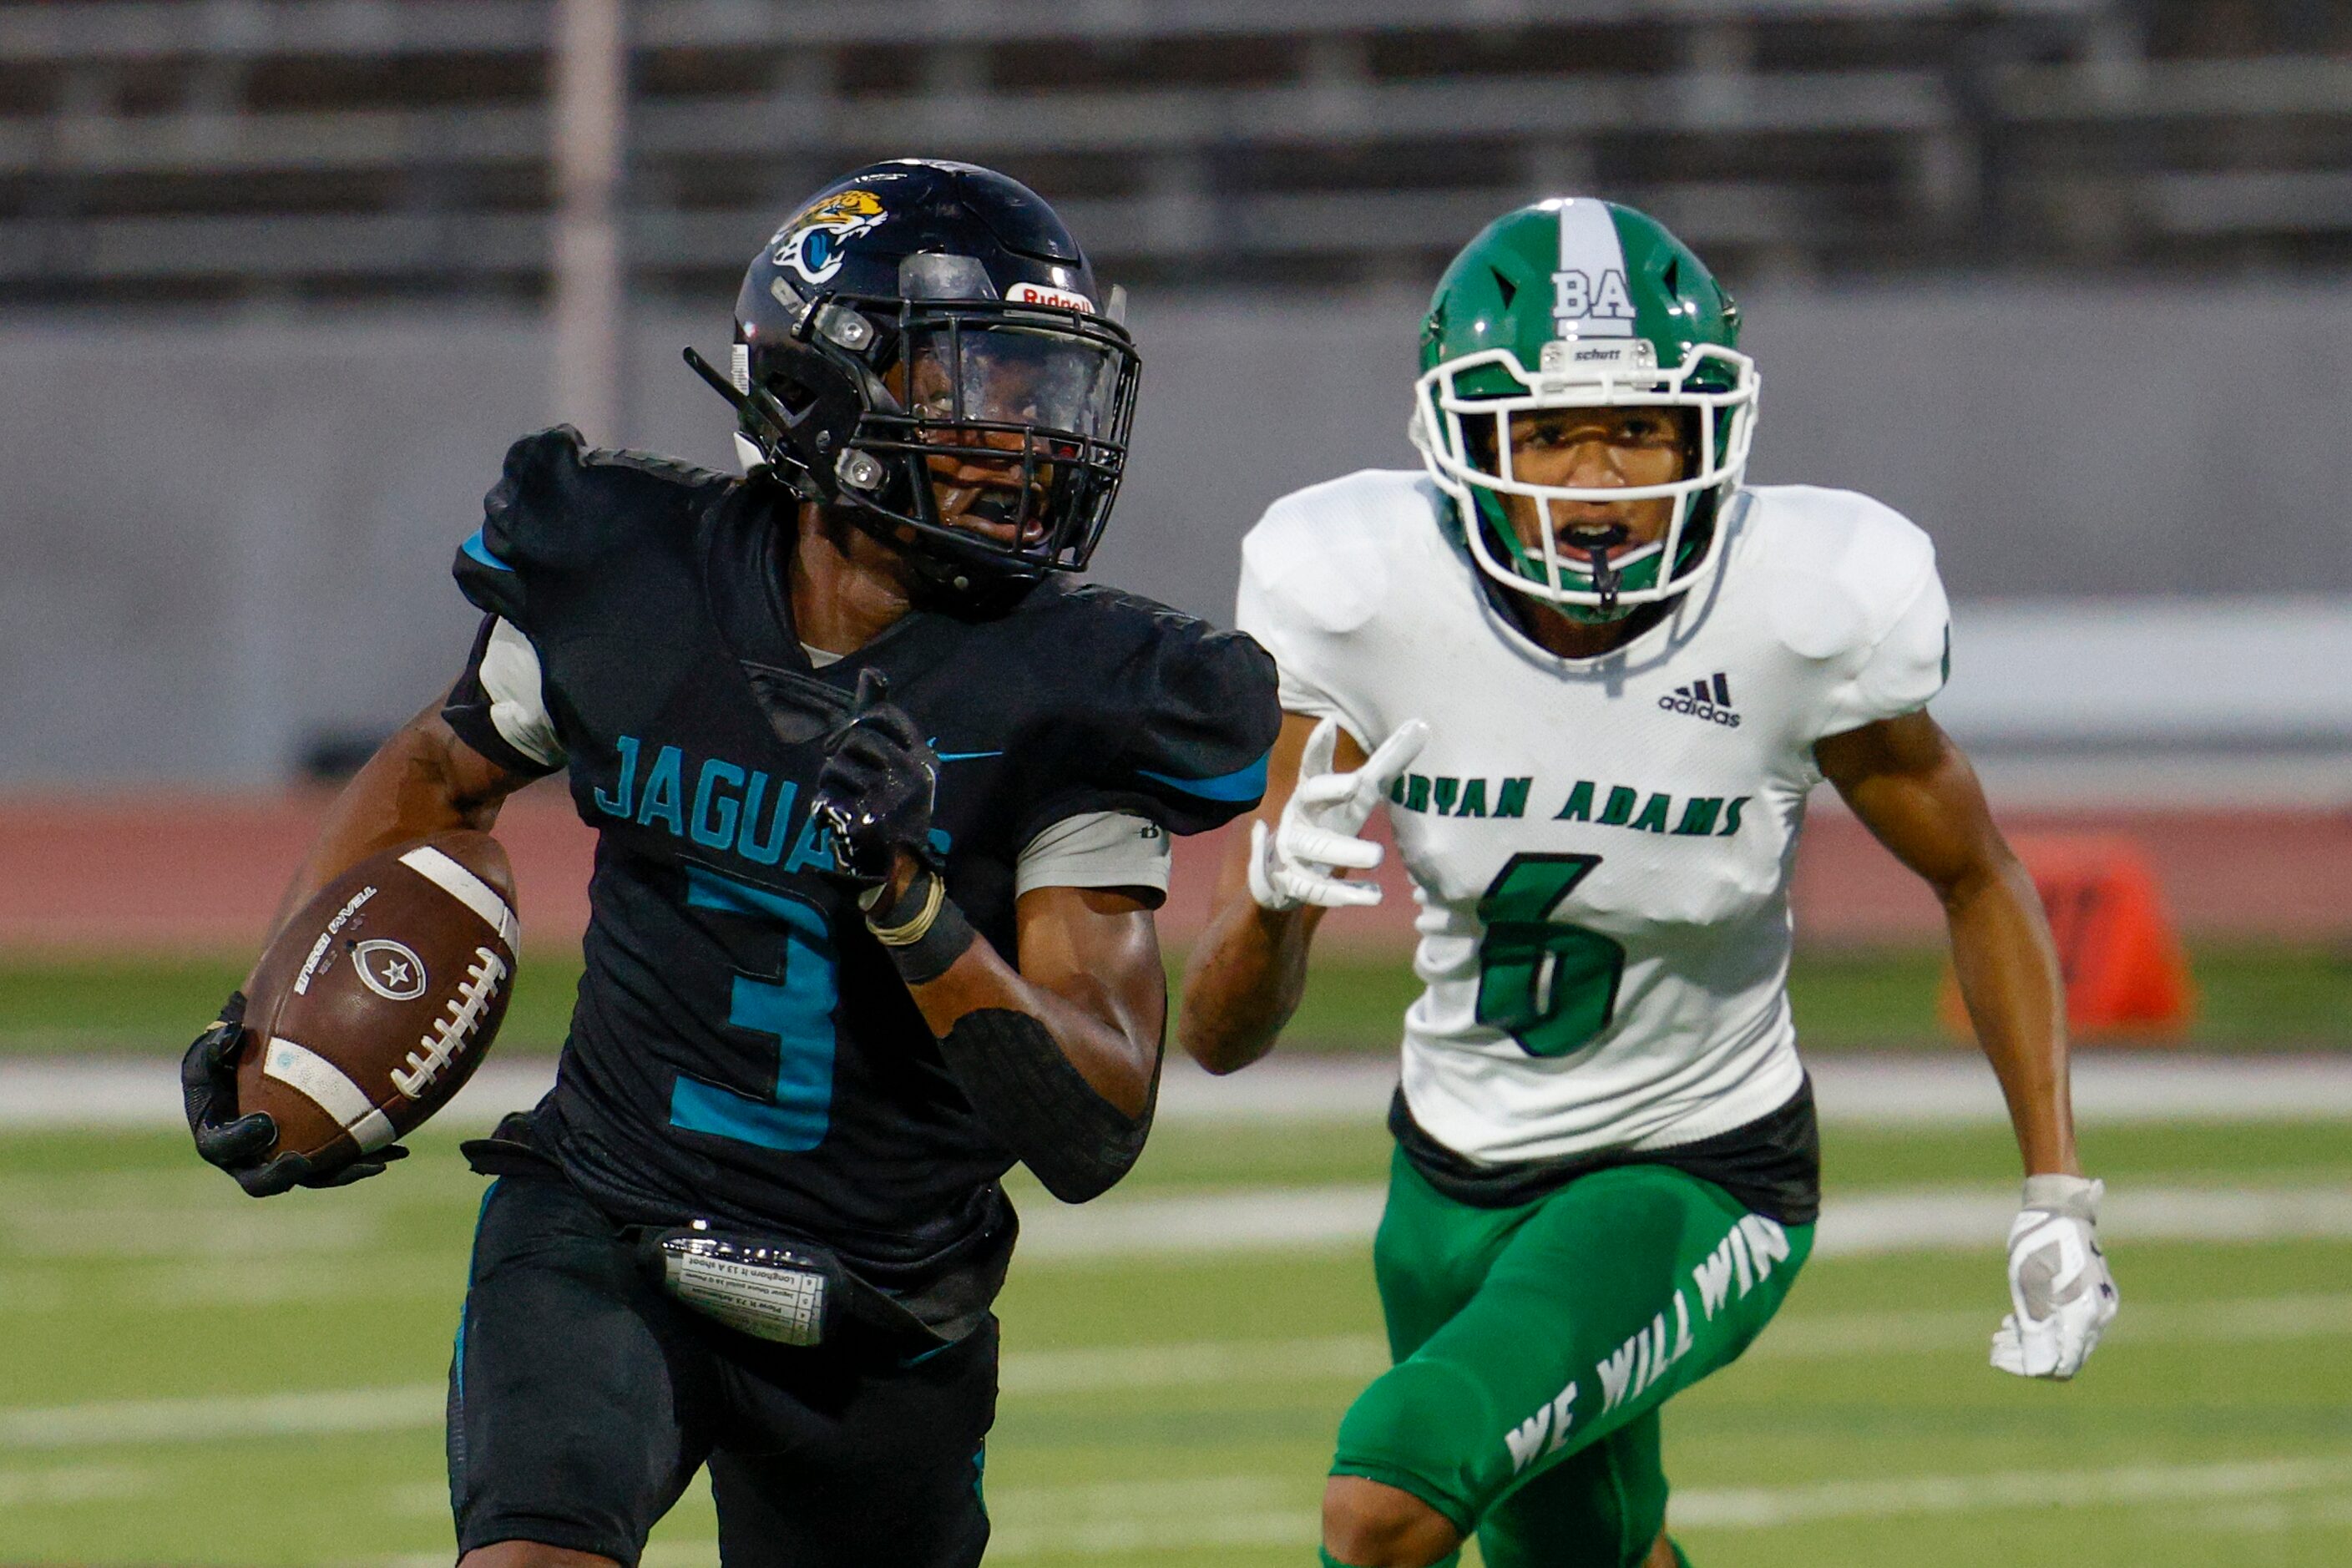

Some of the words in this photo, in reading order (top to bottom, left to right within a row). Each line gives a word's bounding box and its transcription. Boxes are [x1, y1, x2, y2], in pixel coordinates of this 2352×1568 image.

[1550, 269, 1636, 319] BA
[1575, 348, 1621, 361] schutt
[1659, 696, 1741, 728] adidas
[594, 735, 953, 873] JAGUA
[1552, 781, 1754, 837] ADAMS
[328, 886, 377, 934] TEAM
[294, 933, 331, 995] ISSUE
[1475, 852, 1626, 1058] 6
[670, 866, 839, 1152] 3
[726, 1265, 739, 1275] 13
[751, 1269, 795, 1286] Longhorn
[1504, 1381, 1578, 1474] WE
[1596, 1288, 1693, 1417] WILL
[1692, 1213, 1791, 1322] WIN
